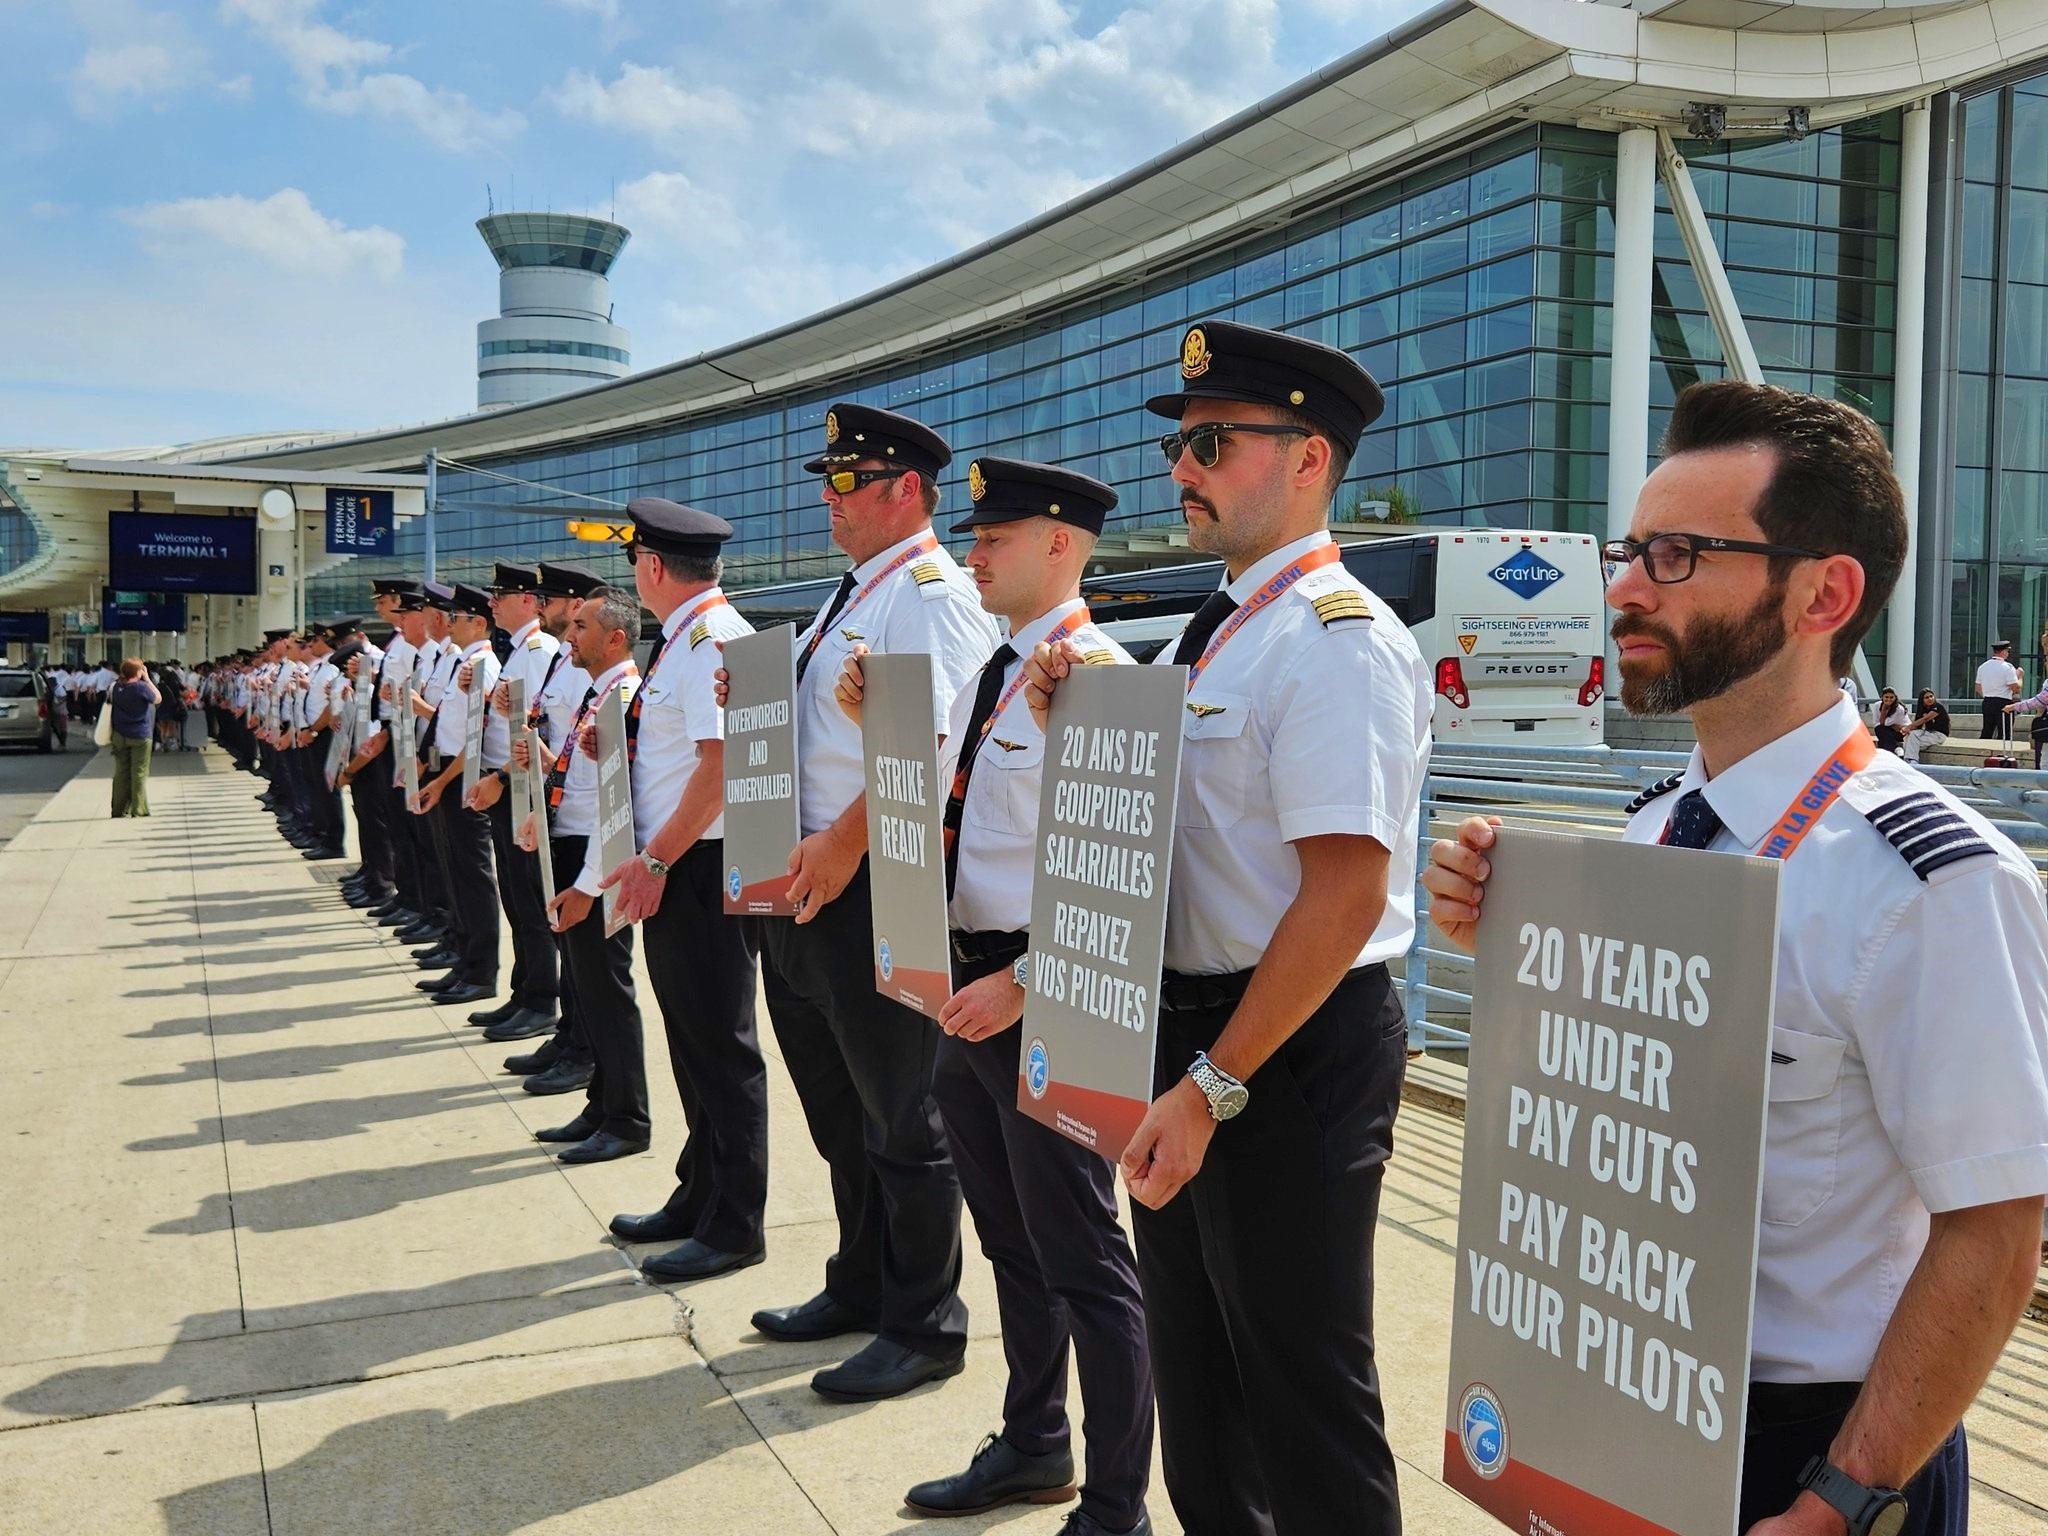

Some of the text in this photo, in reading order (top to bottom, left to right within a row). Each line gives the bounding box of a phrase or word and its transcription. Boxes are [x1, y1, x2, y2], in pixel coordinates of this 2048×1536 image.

[335, 496, 345, 544] TERMINAL
[346, 496, 357, 545] AÉROGARE
[360, 497, 371, 520] 1
[138, 543, 228, 558] TERMINAL 1
[154, 532, 213, 544] Welcome to
[1253, 592, 1269, 605] LA
[1268, 565, 1305, 595] GRÈVE
[1462, 620, 1589, 630] SIGHTSEEING EVERYWHERE
[1485, 665, 1568, 674] PREVOST
[728, 700, 789, 735] OVERWORKED
[748, 740, 768, 767] AND
[1060, 725, 1159, 777] 20 ANS DE
[727, 773, 792, 804] UNDERVALUED
[875, 754, 926, 807] STRIKE
[1782, 812, 1811, 834] LA
[1801, 759, 1853, 810] GRÈVE
[1054, 779, 1155, 837] COUPURES
[880, 814, 926, 868] READY
[1045, 833, 1155, 899] SALARIALES
[1053, 901, 1132, 966] REPAYEZ
[1035, 950, 1147, 1033] VOS PILOTES
[1517, 922, 1711, 1027] 20 YEARS
[1538, 1010, 1673, 1113] UNDER
[1508, 1084, 1698, 1214] PAY CUTS
[1498, 1180, 1697, 1331] PAY BACK
[1468, 1248, 1564, 1359] YOUR
[1577, 1303, 1725, 1441] PILOTS
[1529, 1509, 1538, 1524] For
